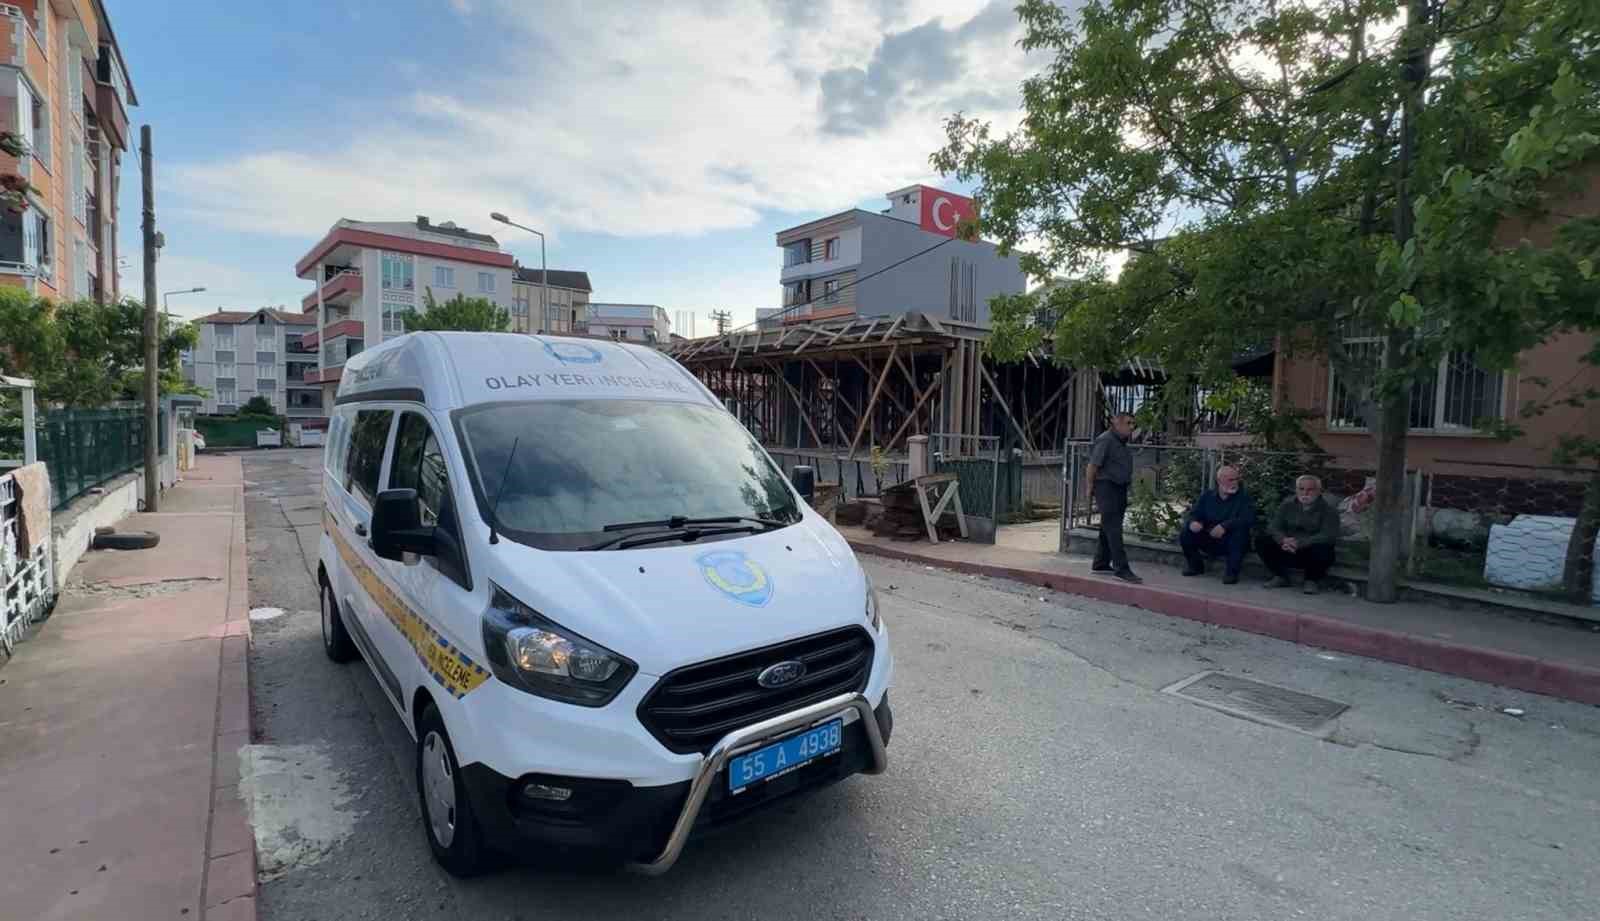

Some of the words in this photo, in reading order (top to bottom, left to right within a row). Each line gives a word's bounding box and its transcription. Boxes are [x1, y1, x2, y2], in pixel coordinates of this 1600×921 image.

[485, 374, 541, 389] OLAY
[742, 753, 765, 780] 55
[775, 745, 787, 769] A
[799, 726, 839, 757] 4938
